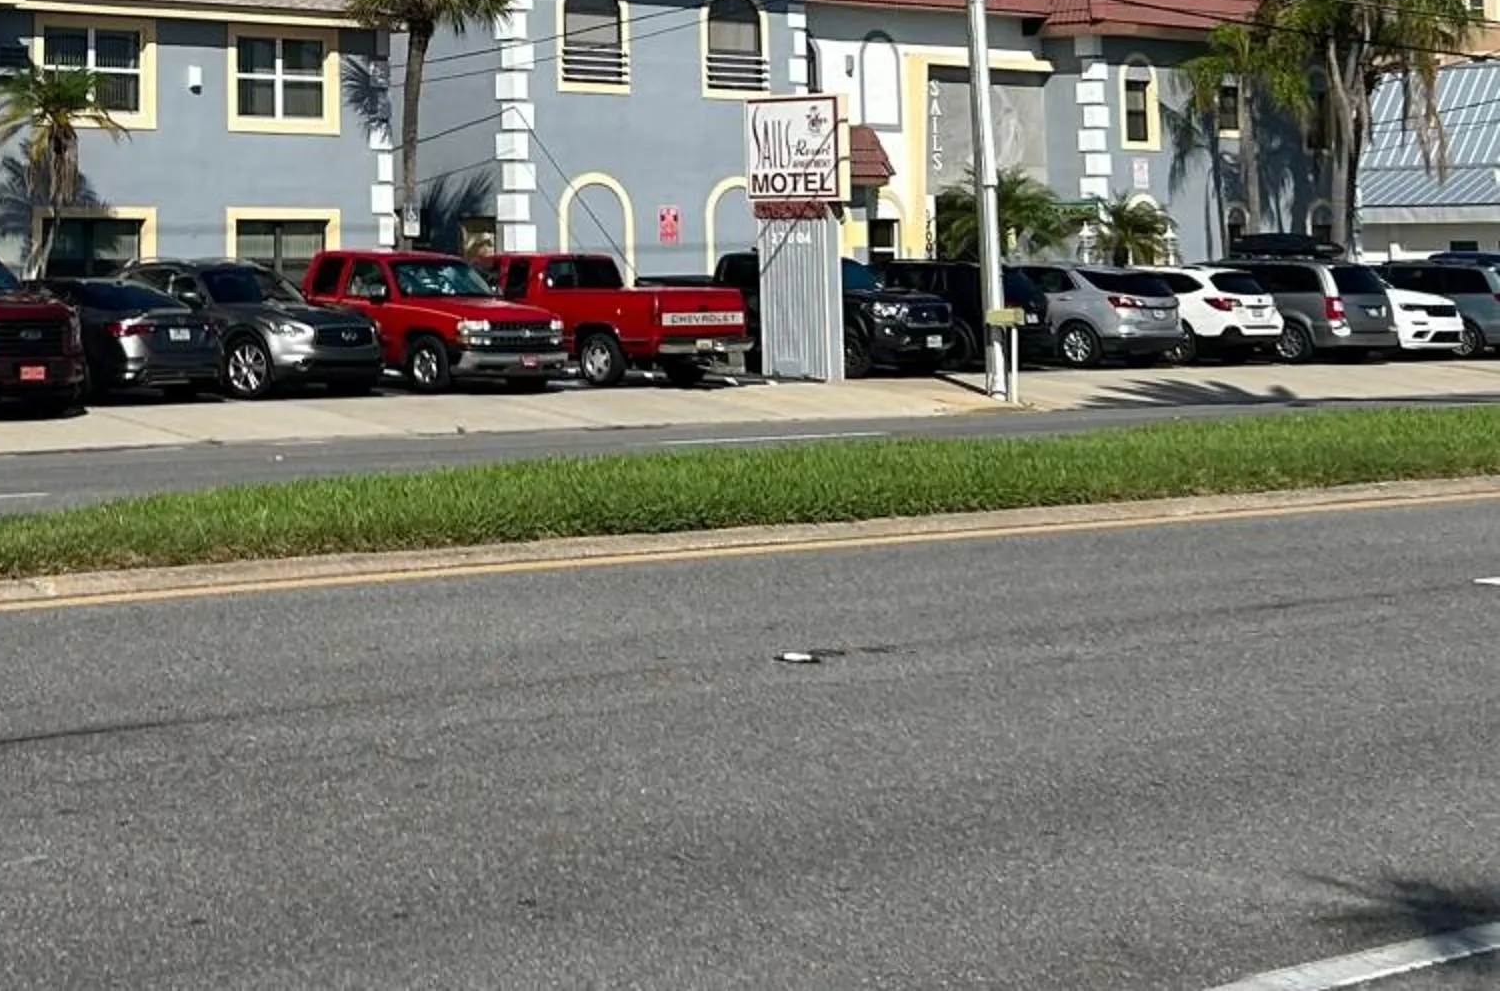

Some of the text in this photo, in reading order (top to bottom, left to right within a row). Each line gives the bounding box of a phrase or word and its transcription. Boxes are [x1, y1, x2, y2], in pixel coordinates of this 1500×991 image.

[751, 105, 792, 171] SAILS
[929, 80, 943, 170] SAILS
[751, 172, 833, 194] MOTEL
[671, 314, 736, 324] CHEVROLET
